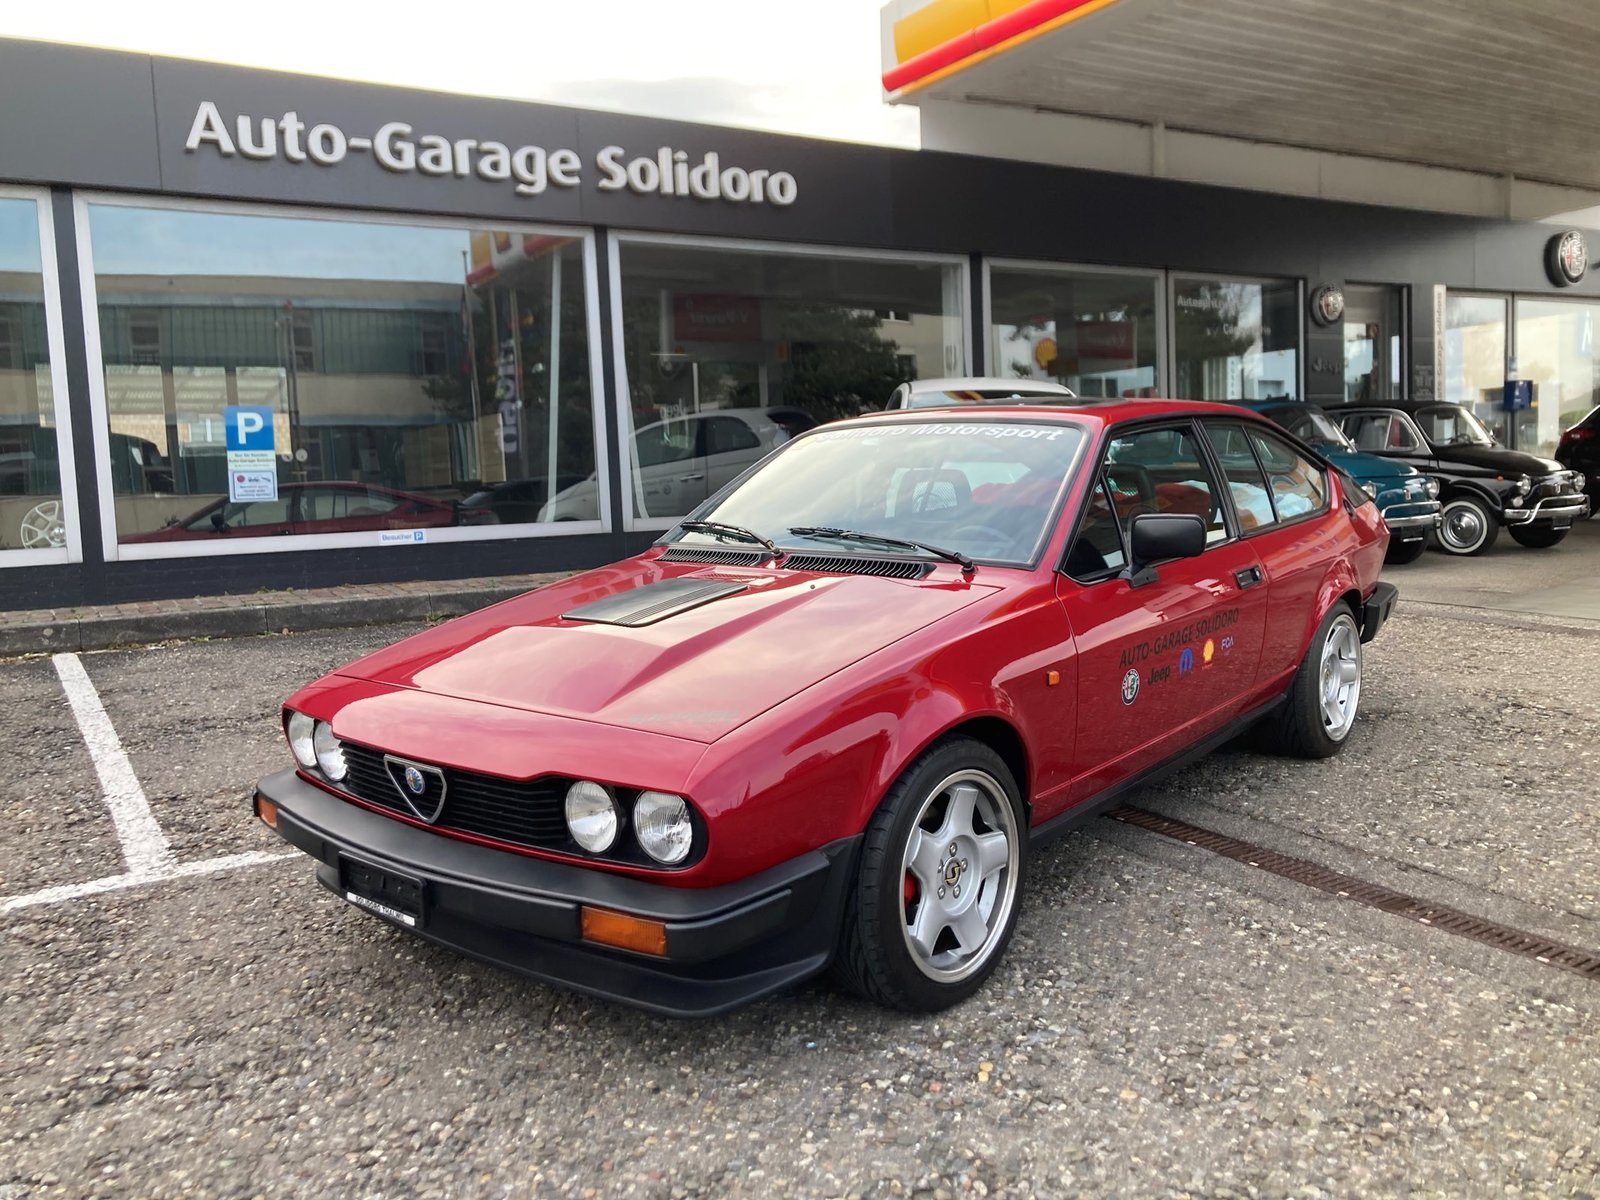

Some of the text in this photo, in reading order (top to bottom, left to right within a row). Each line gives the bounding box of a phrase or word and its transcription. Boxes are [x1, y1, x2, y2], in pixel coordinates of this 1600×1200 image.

[184, 100, 798, 205] Auto-Garage Solidoro
[236, 412, 264, 445] P
[911, 424, 1066, 441] Motorsport
[1119, 607, 1239, 669] AUTO-GARAGE SOLIDORO
[1147, 665, 1171, 686] Jeep
